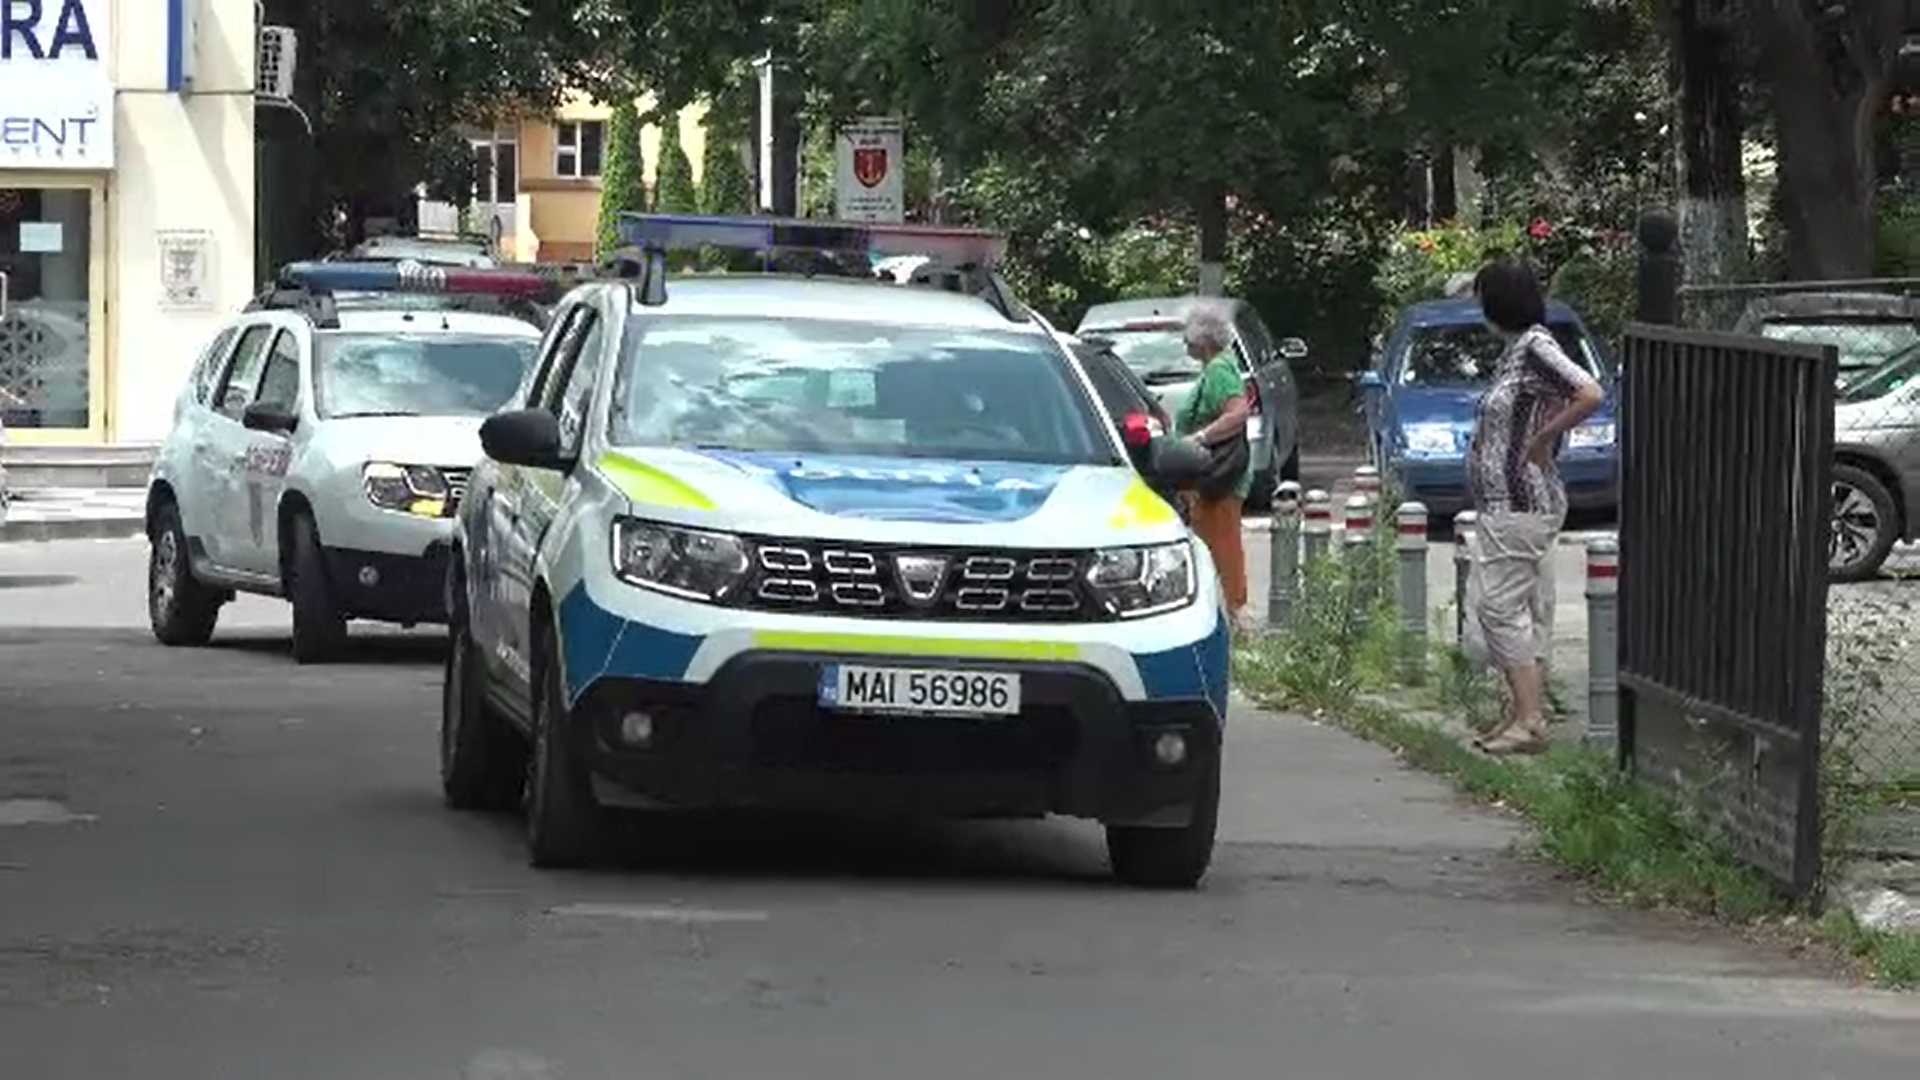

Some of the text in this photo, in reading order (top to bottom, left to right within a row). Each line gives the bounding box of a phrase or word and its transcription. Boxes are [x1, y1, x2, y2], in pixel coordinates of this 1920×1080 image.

[1, 0, 98, 60] RA
[0, 117, 96, 144] ENT
[846, 671, 1009, 708] MAI 56986
